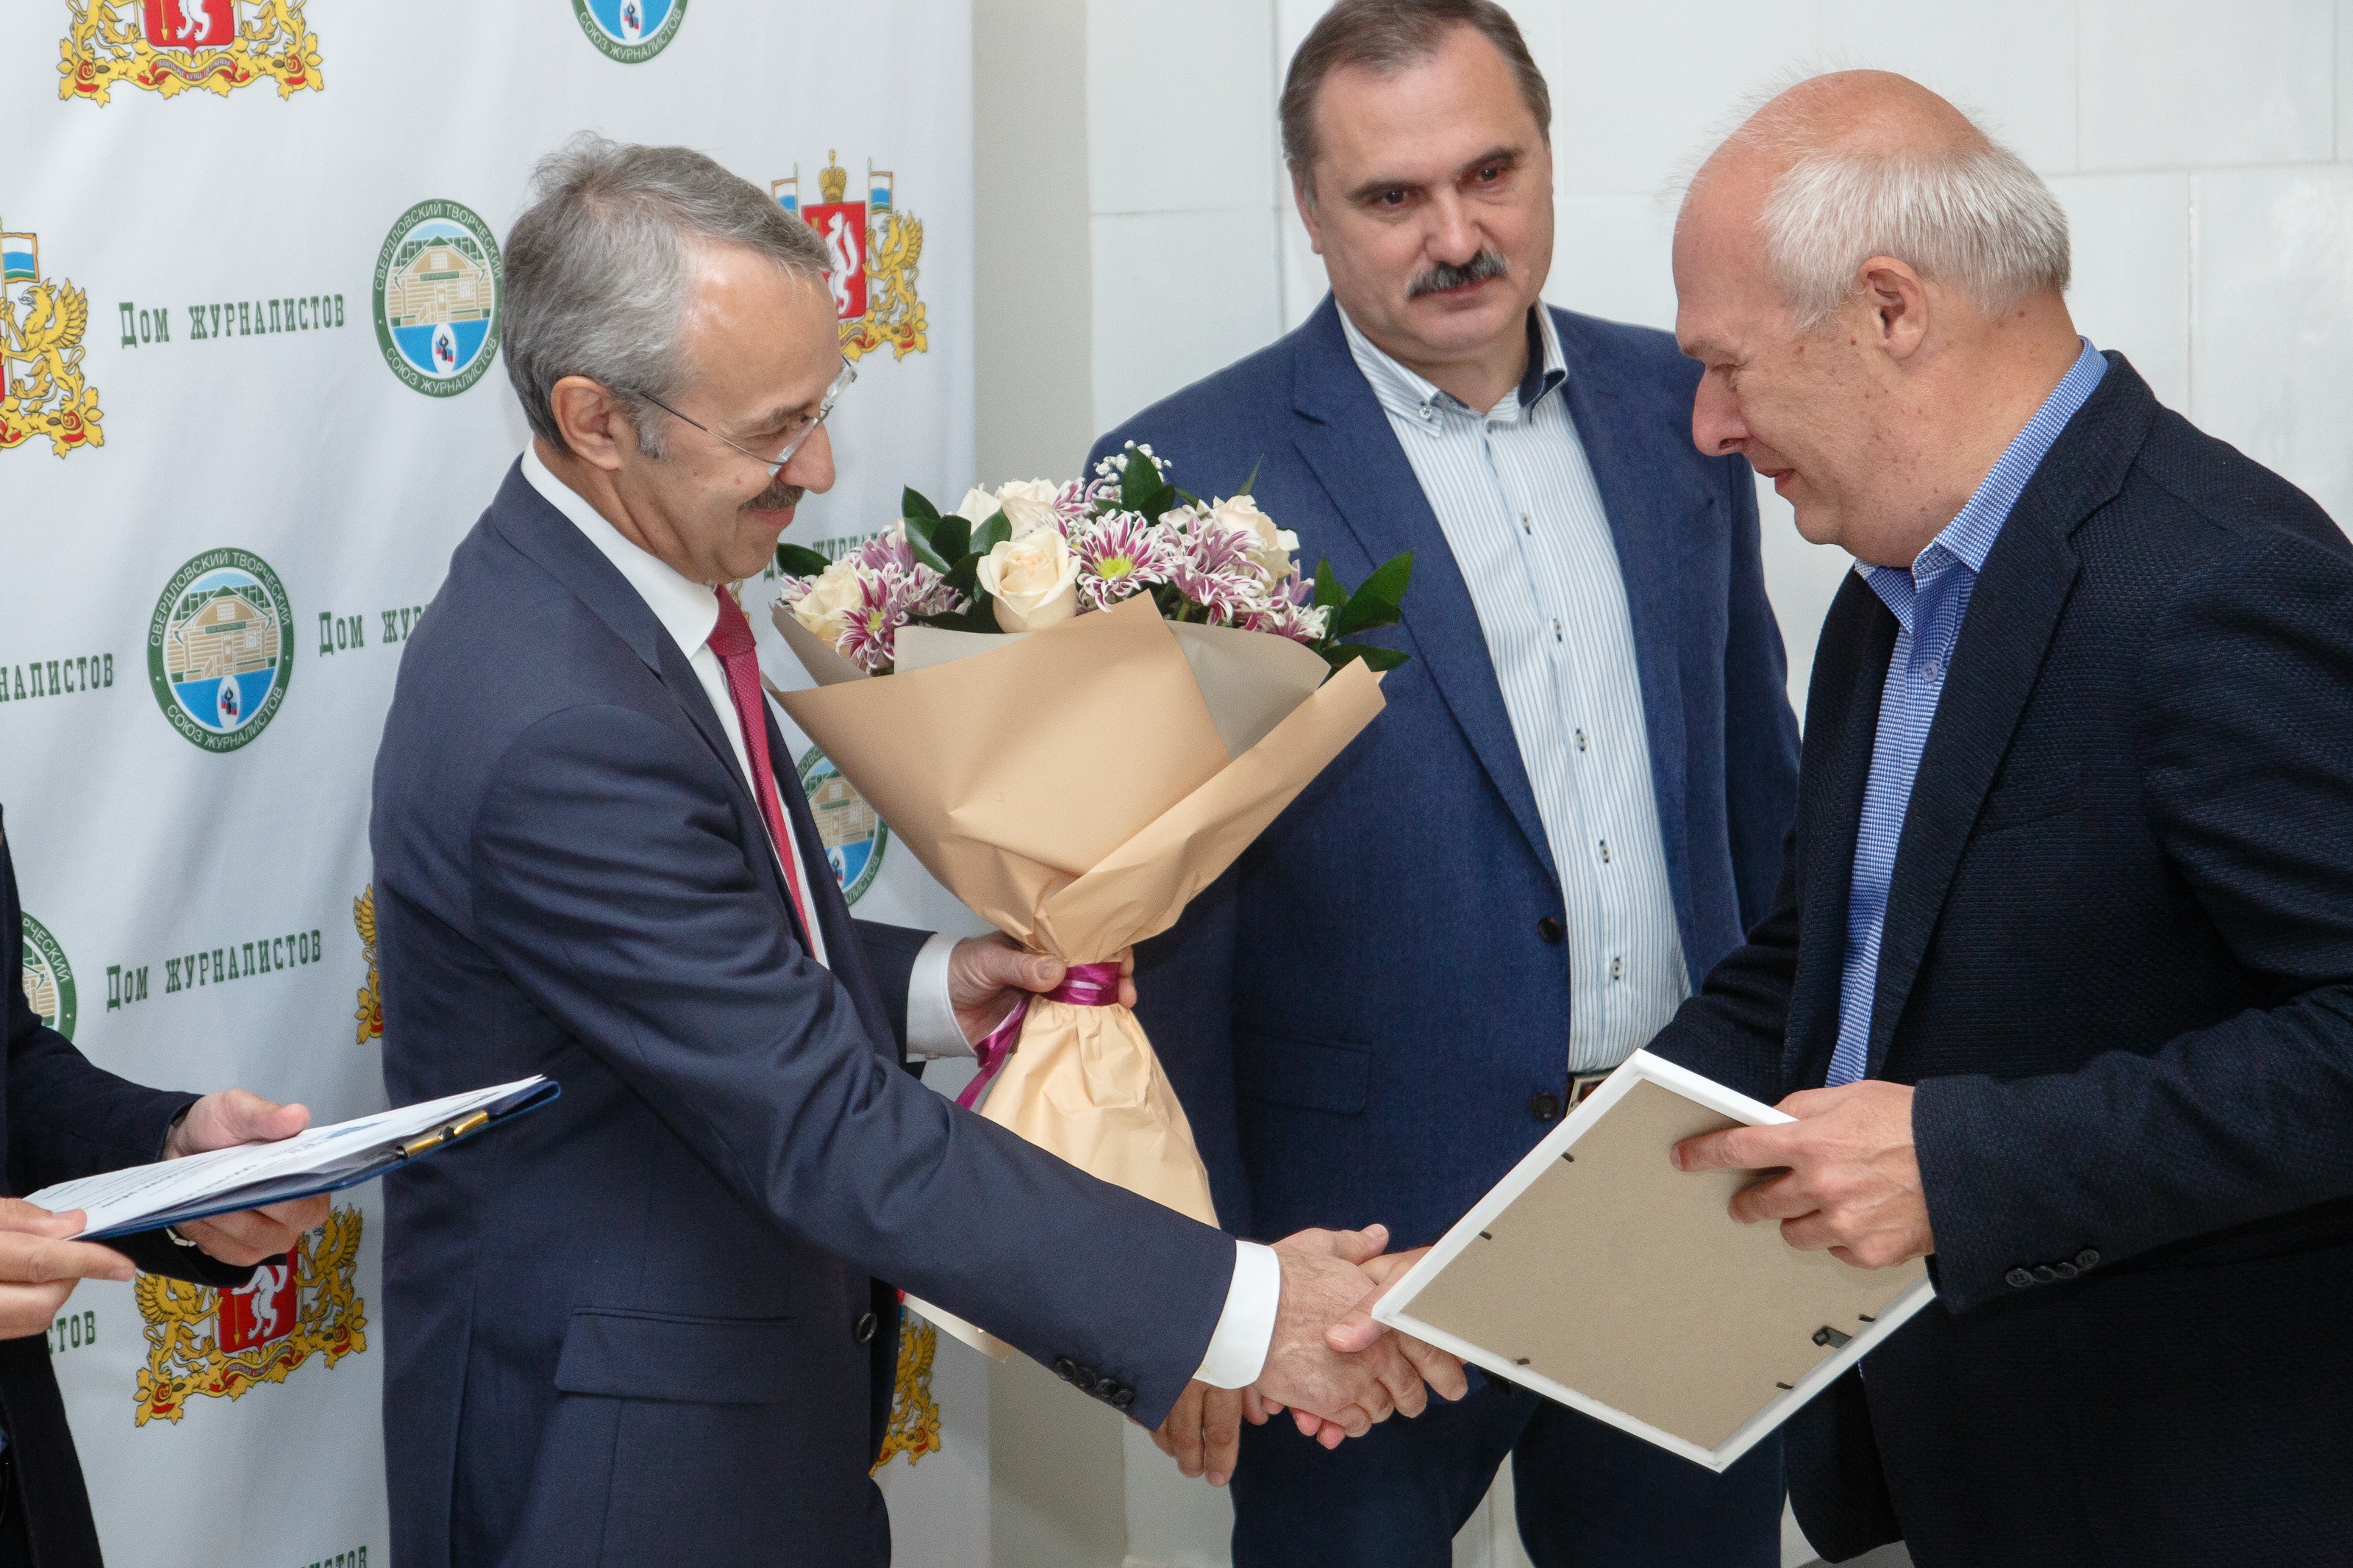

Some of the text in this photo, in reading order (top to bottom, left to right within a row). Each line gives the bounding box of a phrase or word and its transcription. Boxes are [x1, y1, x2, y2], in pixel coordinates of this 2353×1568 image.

[579, 8, 682, 60] СОЮЗ ЖУРНАЛИСТОВ
[375, 201, 441, 290] СВЕРДЛОВСКИЙ
[386, 337, 497, 394] СОЮЗ ЖУРНАЛИСТОВ
[150, 550, 290, 646] СВЕРДЛОВСКИЙ ТВОРЧЕСКИЙ
[381, 604, 432, 644] ЖУР
[167, 687, 283, 749] СОЮЗ ЖУРНАЛИСТОВ
